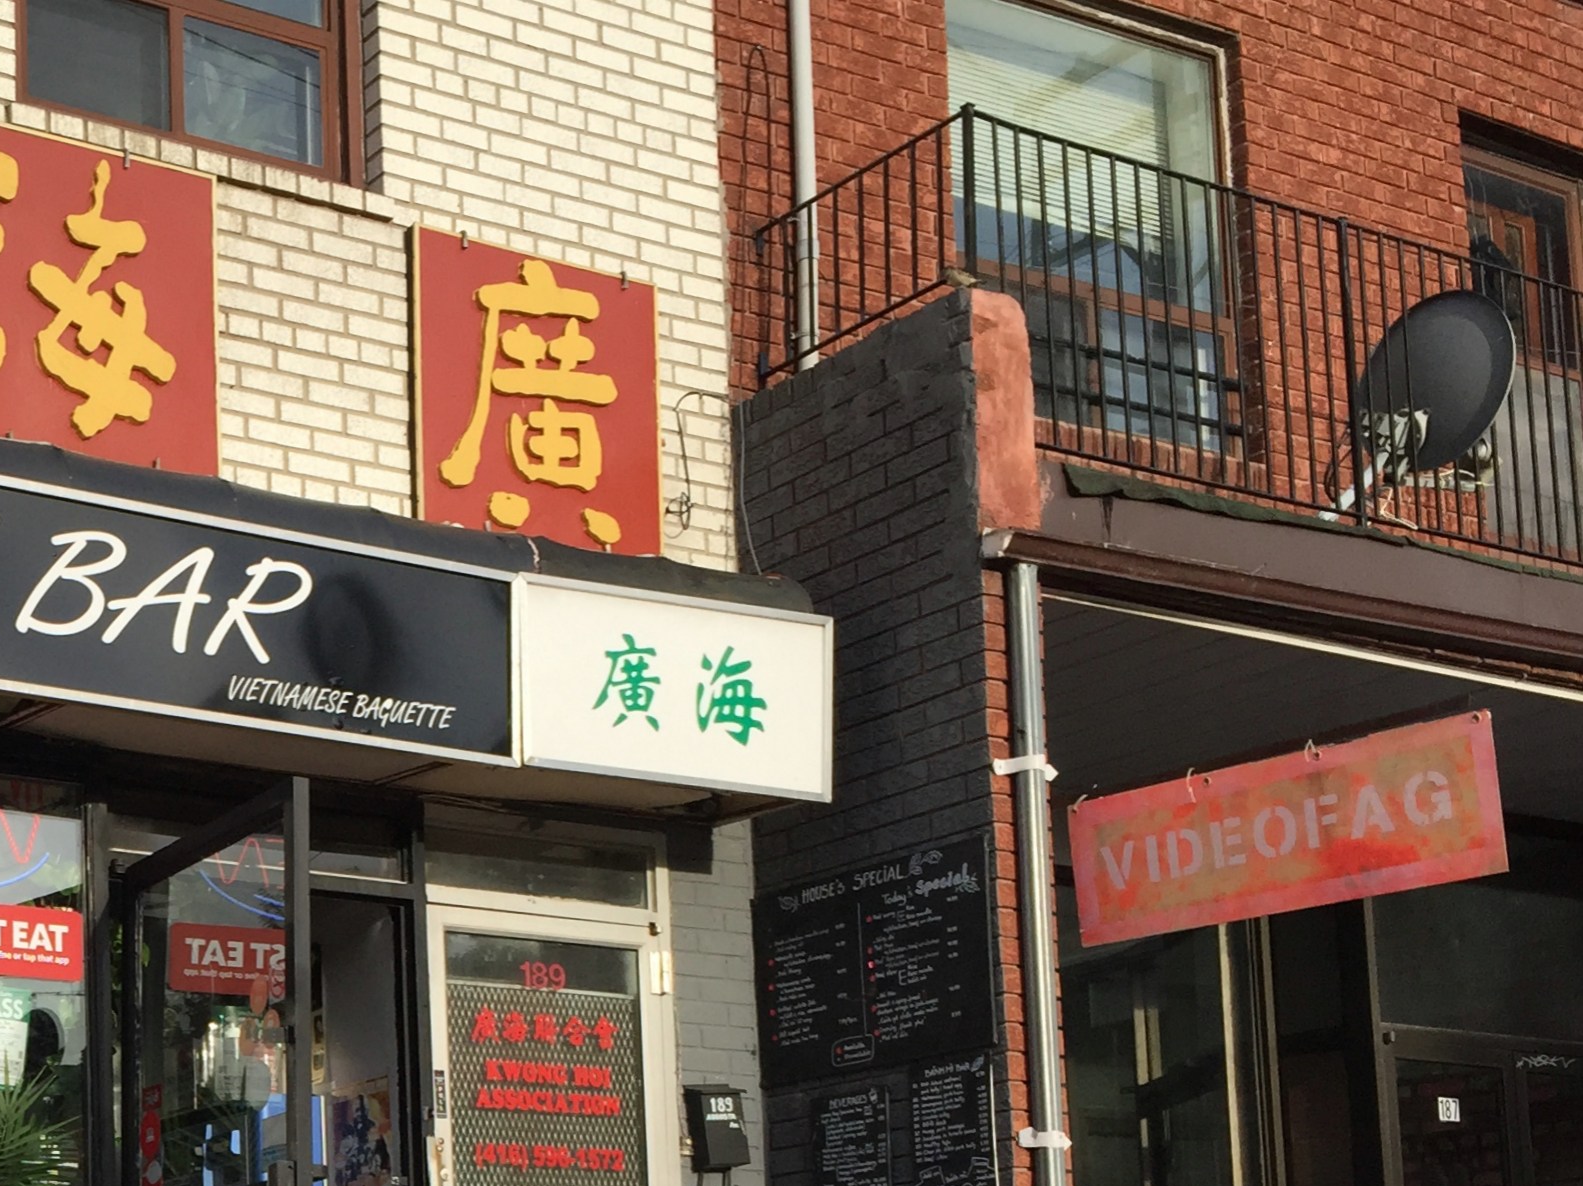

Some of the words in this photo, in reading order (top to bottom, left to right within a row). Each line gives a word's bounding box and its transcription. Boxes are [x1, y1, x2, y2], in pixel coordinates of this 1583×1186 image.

[440, 259, 620, 546] 廣
[16, 530, 312, 665] BAR
[228, 675, 352, 716] VIETNAMESE
[354, 694, 456, 731] BAGUETTE
[593, 634, 768, 747] 廣海
[1101, 770, 1453, 890] VIDEOFAG
[852, 863, 906, 891] SPECIAL
[12, 920, 69, 952] EAT
[23, 951, 37, 963] tap
[37, 953, 53, 963] that
[54, 956, 70, 966] app
[520, 960, 566, 991] 189
[485, 1059, 568, 1086] KWONG
[573, 1065, 613, 1089] HOI
[476, 1087, 621, 1116] ASSOCIATION
[710, 1097, 734, 1112] 189
[1439, 1099, 1460, 1120] 187
[475, 1142, 529, 1172] (416)
